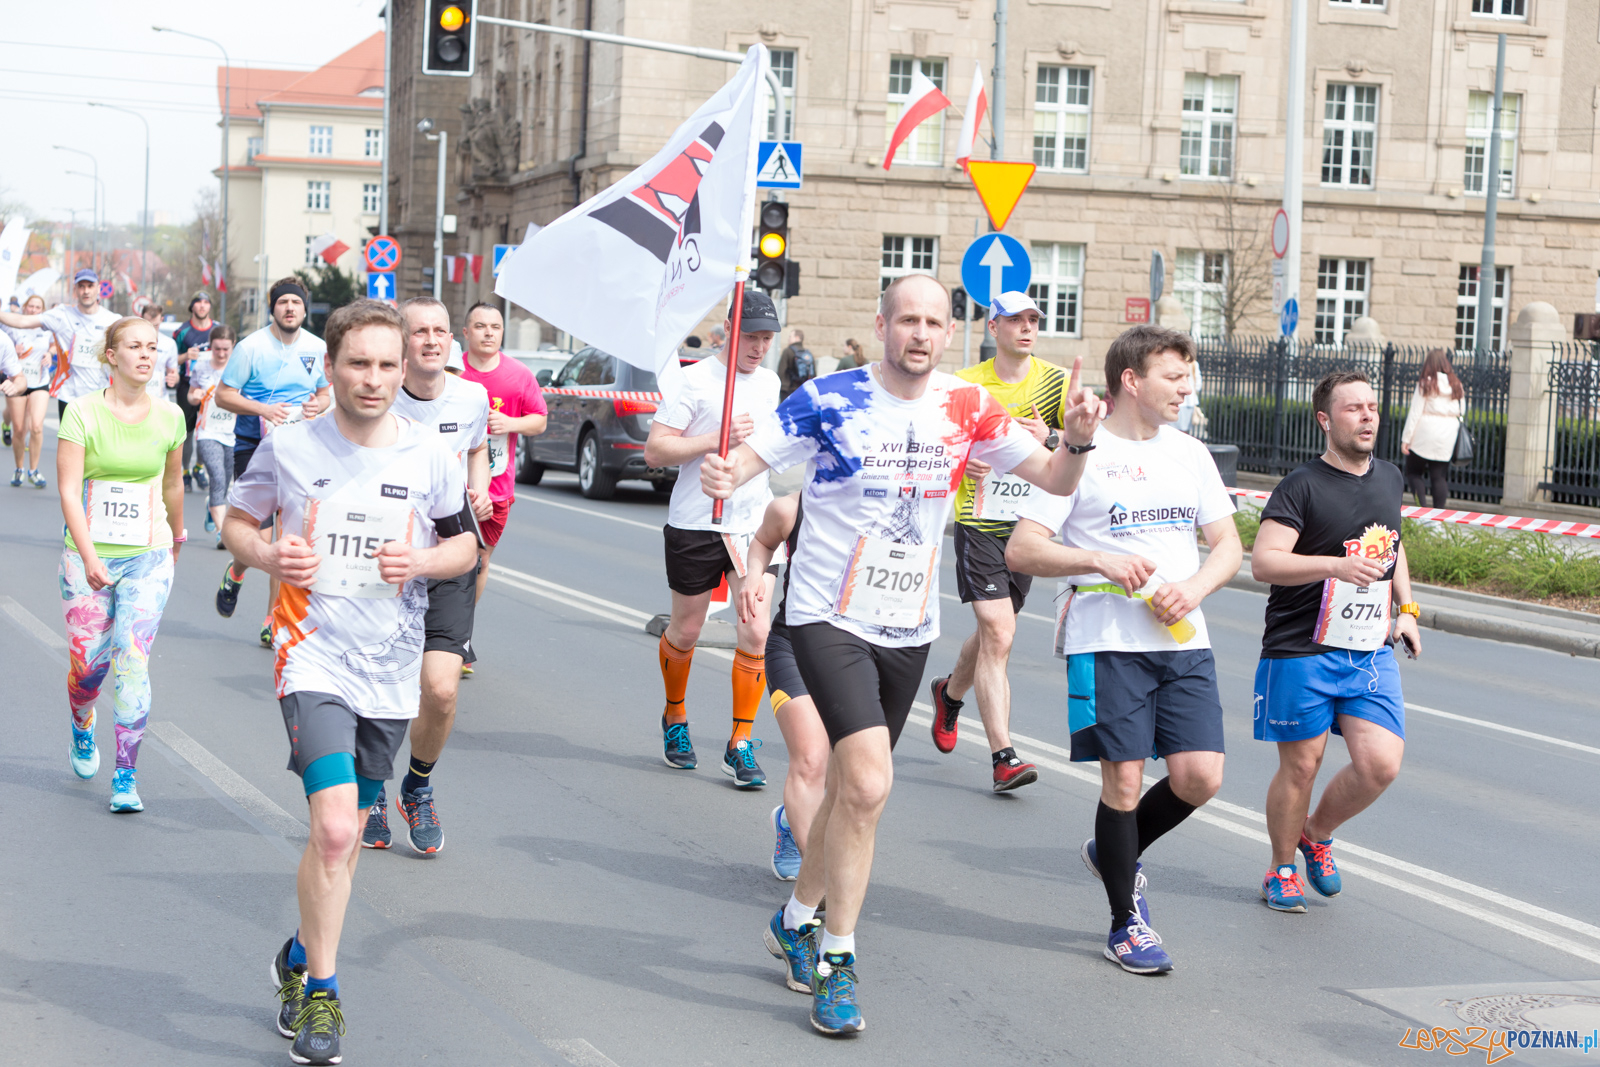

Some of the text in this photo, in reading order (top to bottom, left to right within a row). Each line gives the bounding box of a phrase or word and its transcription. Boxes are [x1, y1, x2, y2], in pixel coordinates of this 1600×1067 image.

[210, 411, 234, 421] 4635
[880, 442, 945, 457] XVI Bieg
[893, 473, 934, 481] 07.04.2018
[991, 480, 1031, 497] 7202
[103, 501, 140, 519] 1125
[1110, 512, 1128, 526] AP
[327, 533, 397, 560] 1115
[866, 565, 925, 593] 12109
[880, 594, 904, 603] Tomasz
[1340, 602, 1382, 621] 6774
